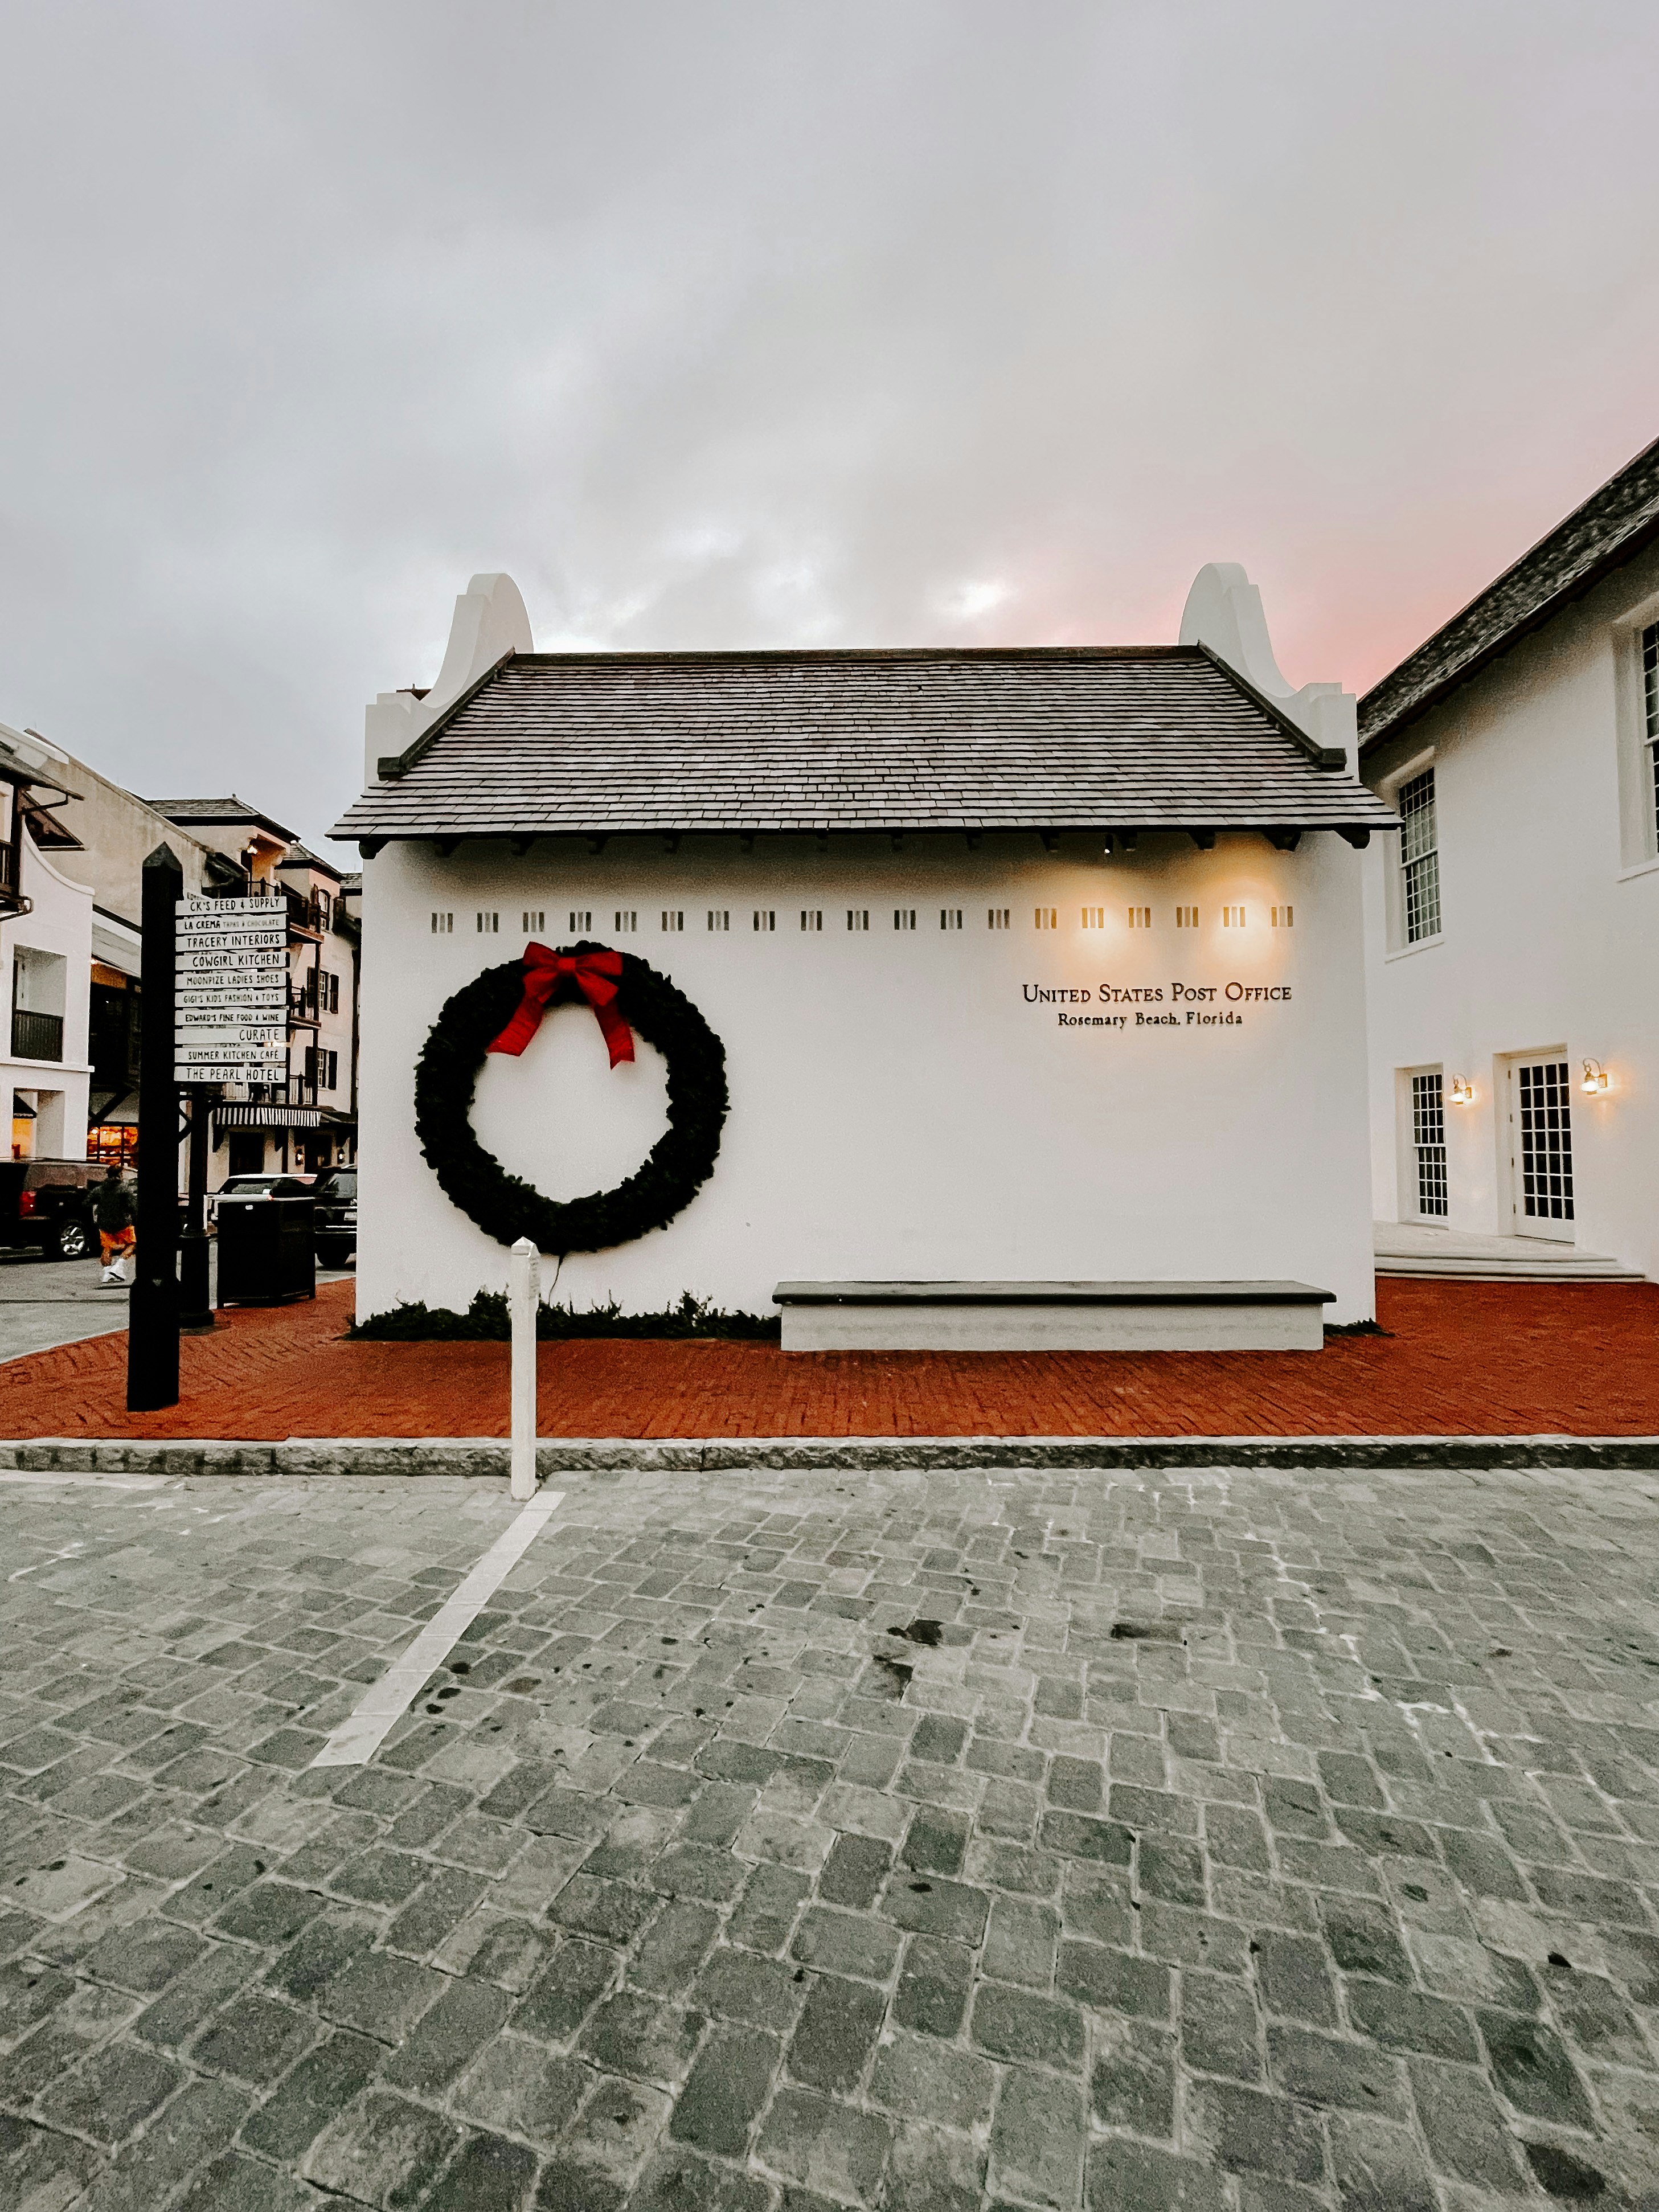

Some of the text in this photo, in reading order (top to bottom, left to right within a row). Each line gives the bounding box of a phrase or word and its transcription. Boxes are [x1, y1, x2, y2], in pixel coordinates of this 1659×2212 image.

[190, 902, 210, 911] CK'S
[215, 900, 236, 910] FEED
[249, 898, 280, 908] SUPPLY
[196, 920, 220, 929] CREMA
[187, 935, 280, 948] TRACERY INTERIORS
[193, 955, 279, 967] COWGIRL KITCHEN
[228, 975, 253, 984] LADIES
[256, 974, 278, 983] SHOES
[1058, 1013, 1127, 1029] Rosemary
[1186, 1011, 1243, 1025] Florida
[239, 1029, 280, 1041] CURATE
[189, 1051, 219, 1060] SUMMER
[223, 1051, 256, 1059] KITCHEN
[187, 1068, 278, 1080] THE PEARL HOTEL
